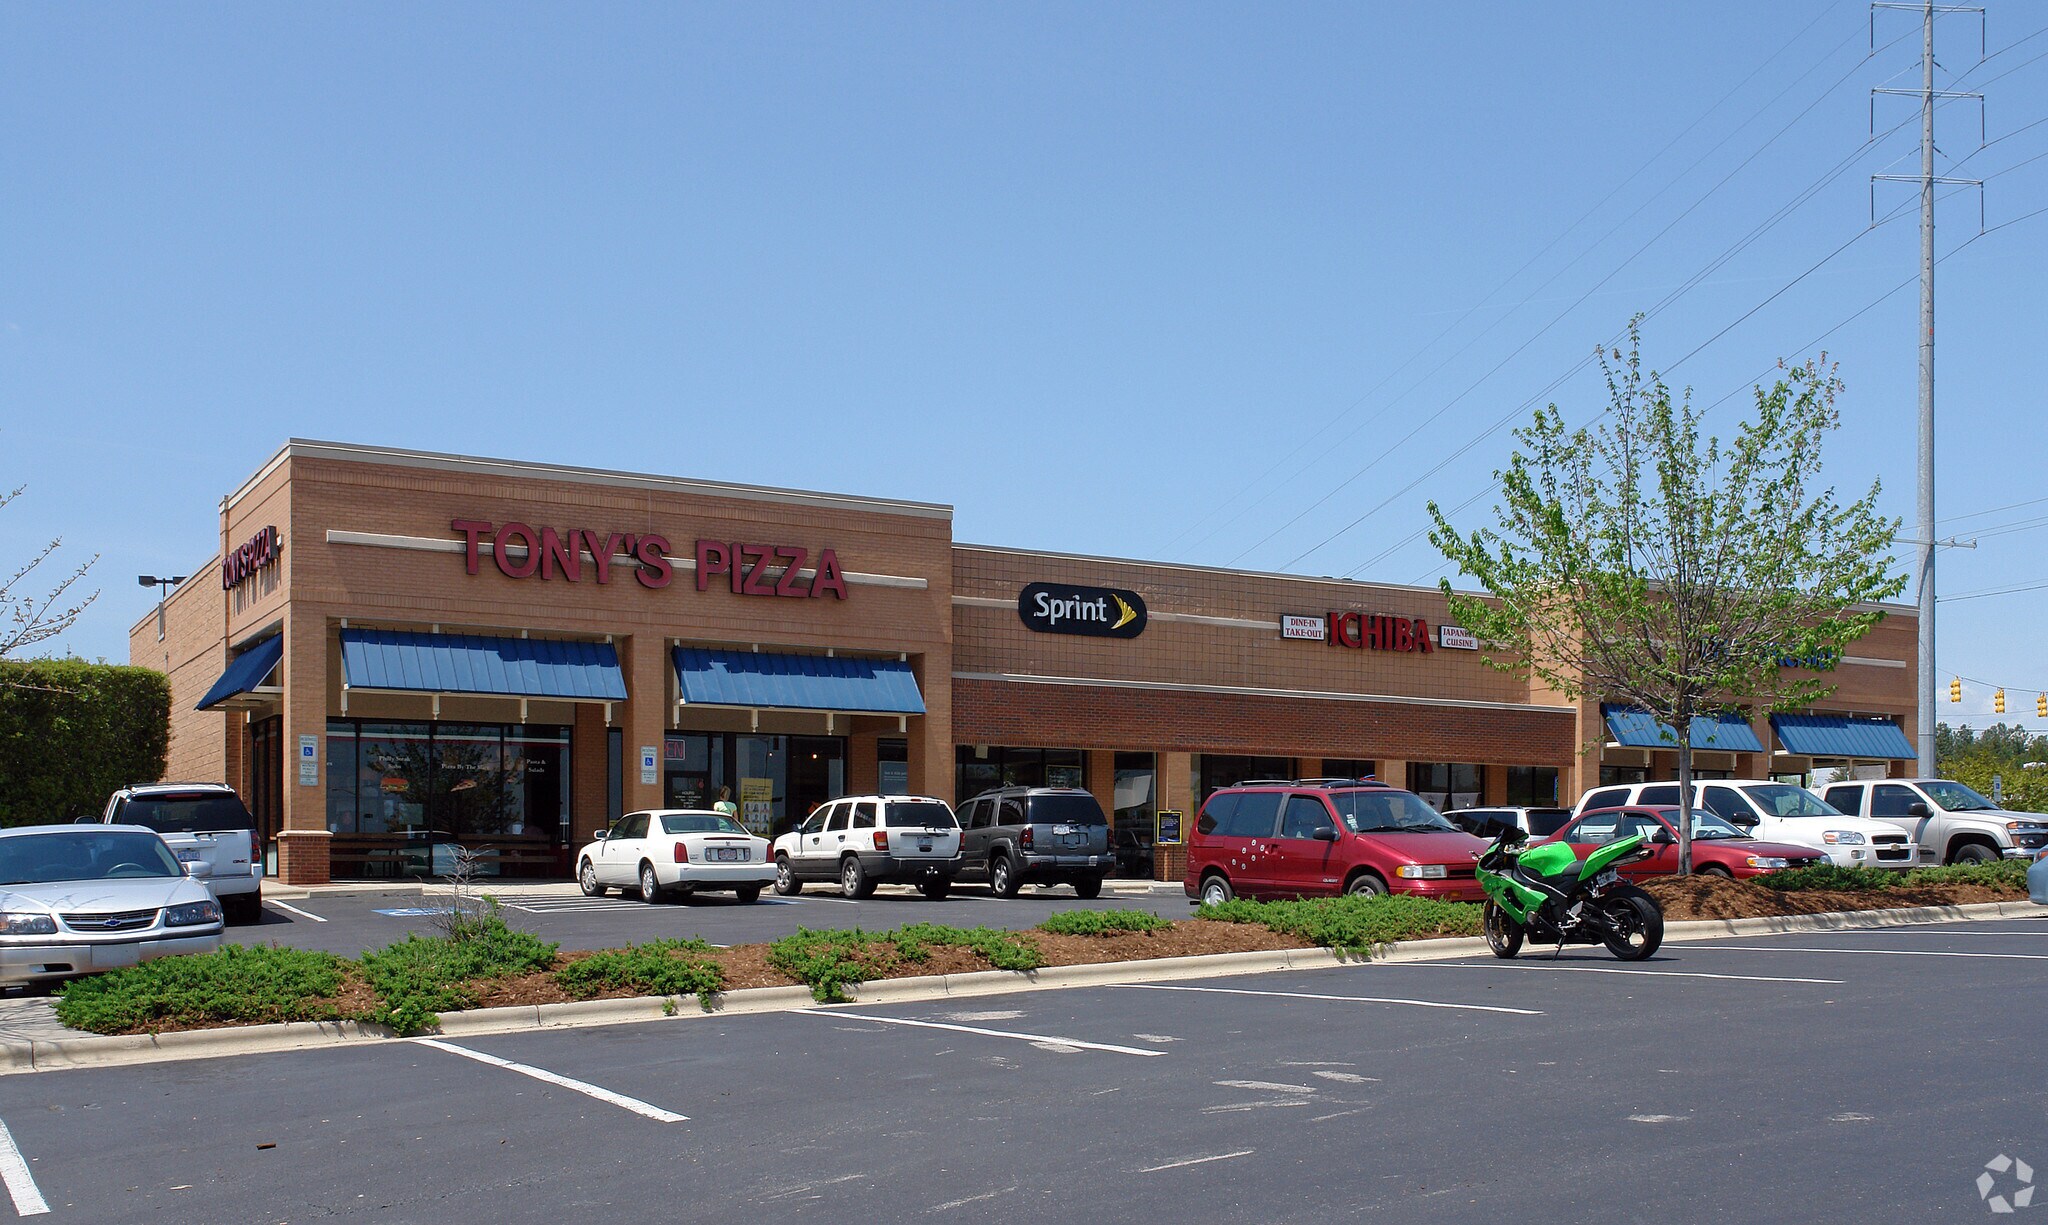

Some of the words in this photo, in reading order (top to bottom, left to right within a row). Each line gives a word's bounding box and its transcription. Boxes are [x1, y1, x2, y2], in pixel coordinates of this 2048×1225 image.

[451, 519, 672, 588] TONY'S
[696, 540, 848, 599] PIZZA
[1034, 591, 1108, 626] Sprint
[1327, 611, 1434, 653] ICHIBA
[1446, 638, 1474, 648] CUISINE
